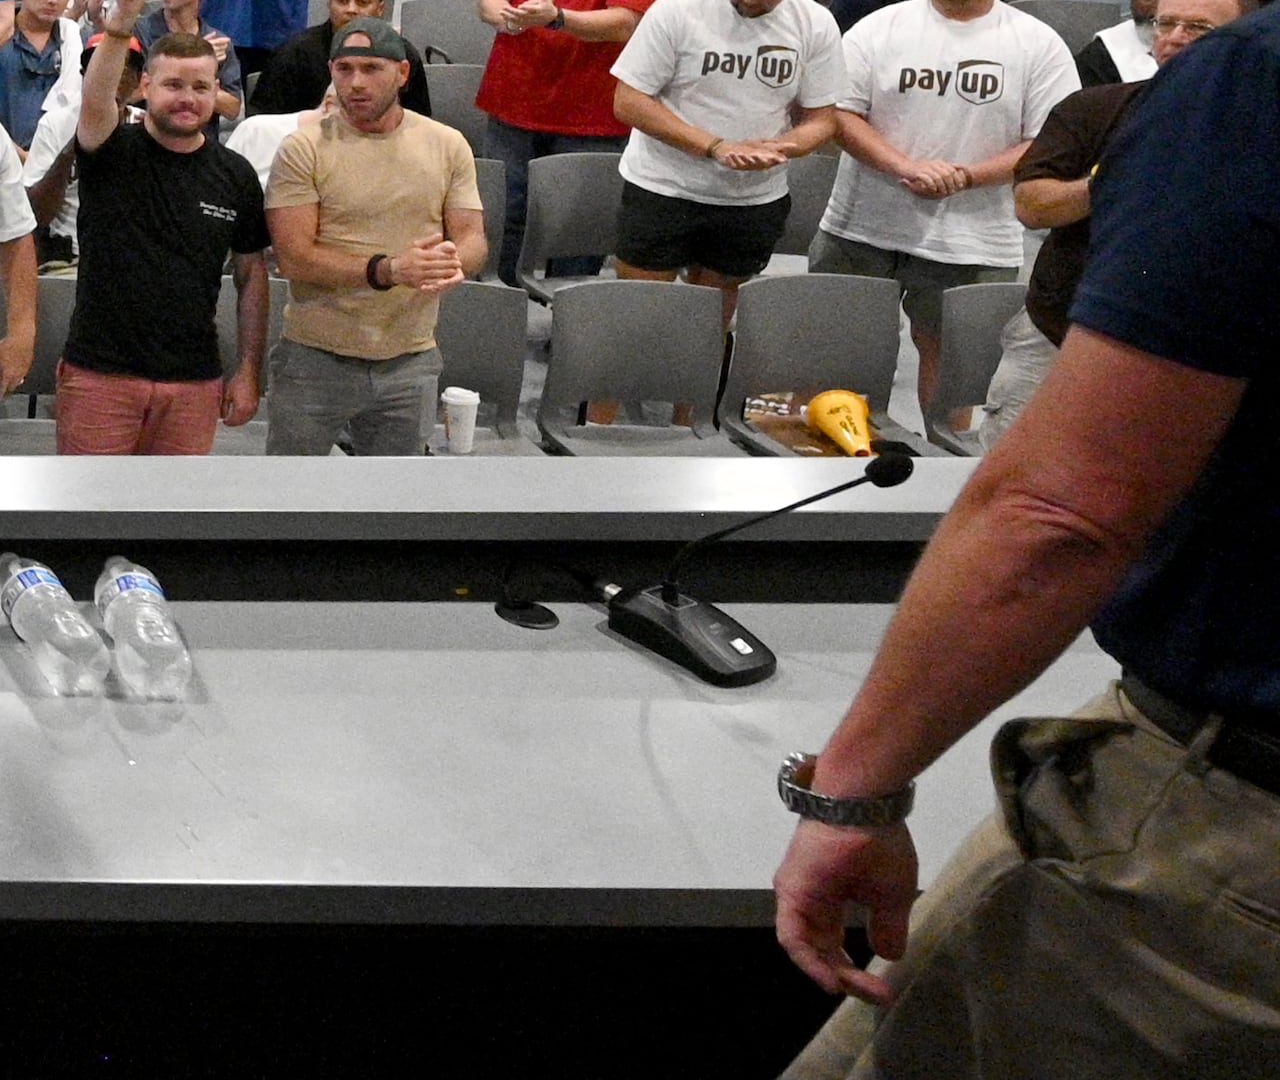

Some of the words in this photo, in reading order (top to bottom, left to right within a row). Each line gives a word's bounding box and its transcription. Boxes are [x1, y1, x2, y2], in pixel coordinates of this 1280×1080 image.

[702, 49, 752, 79] pay
[759, 52, 793, 88] up
[898, 66, 952, 98] pay
[959, 70, 1000, 102] up
